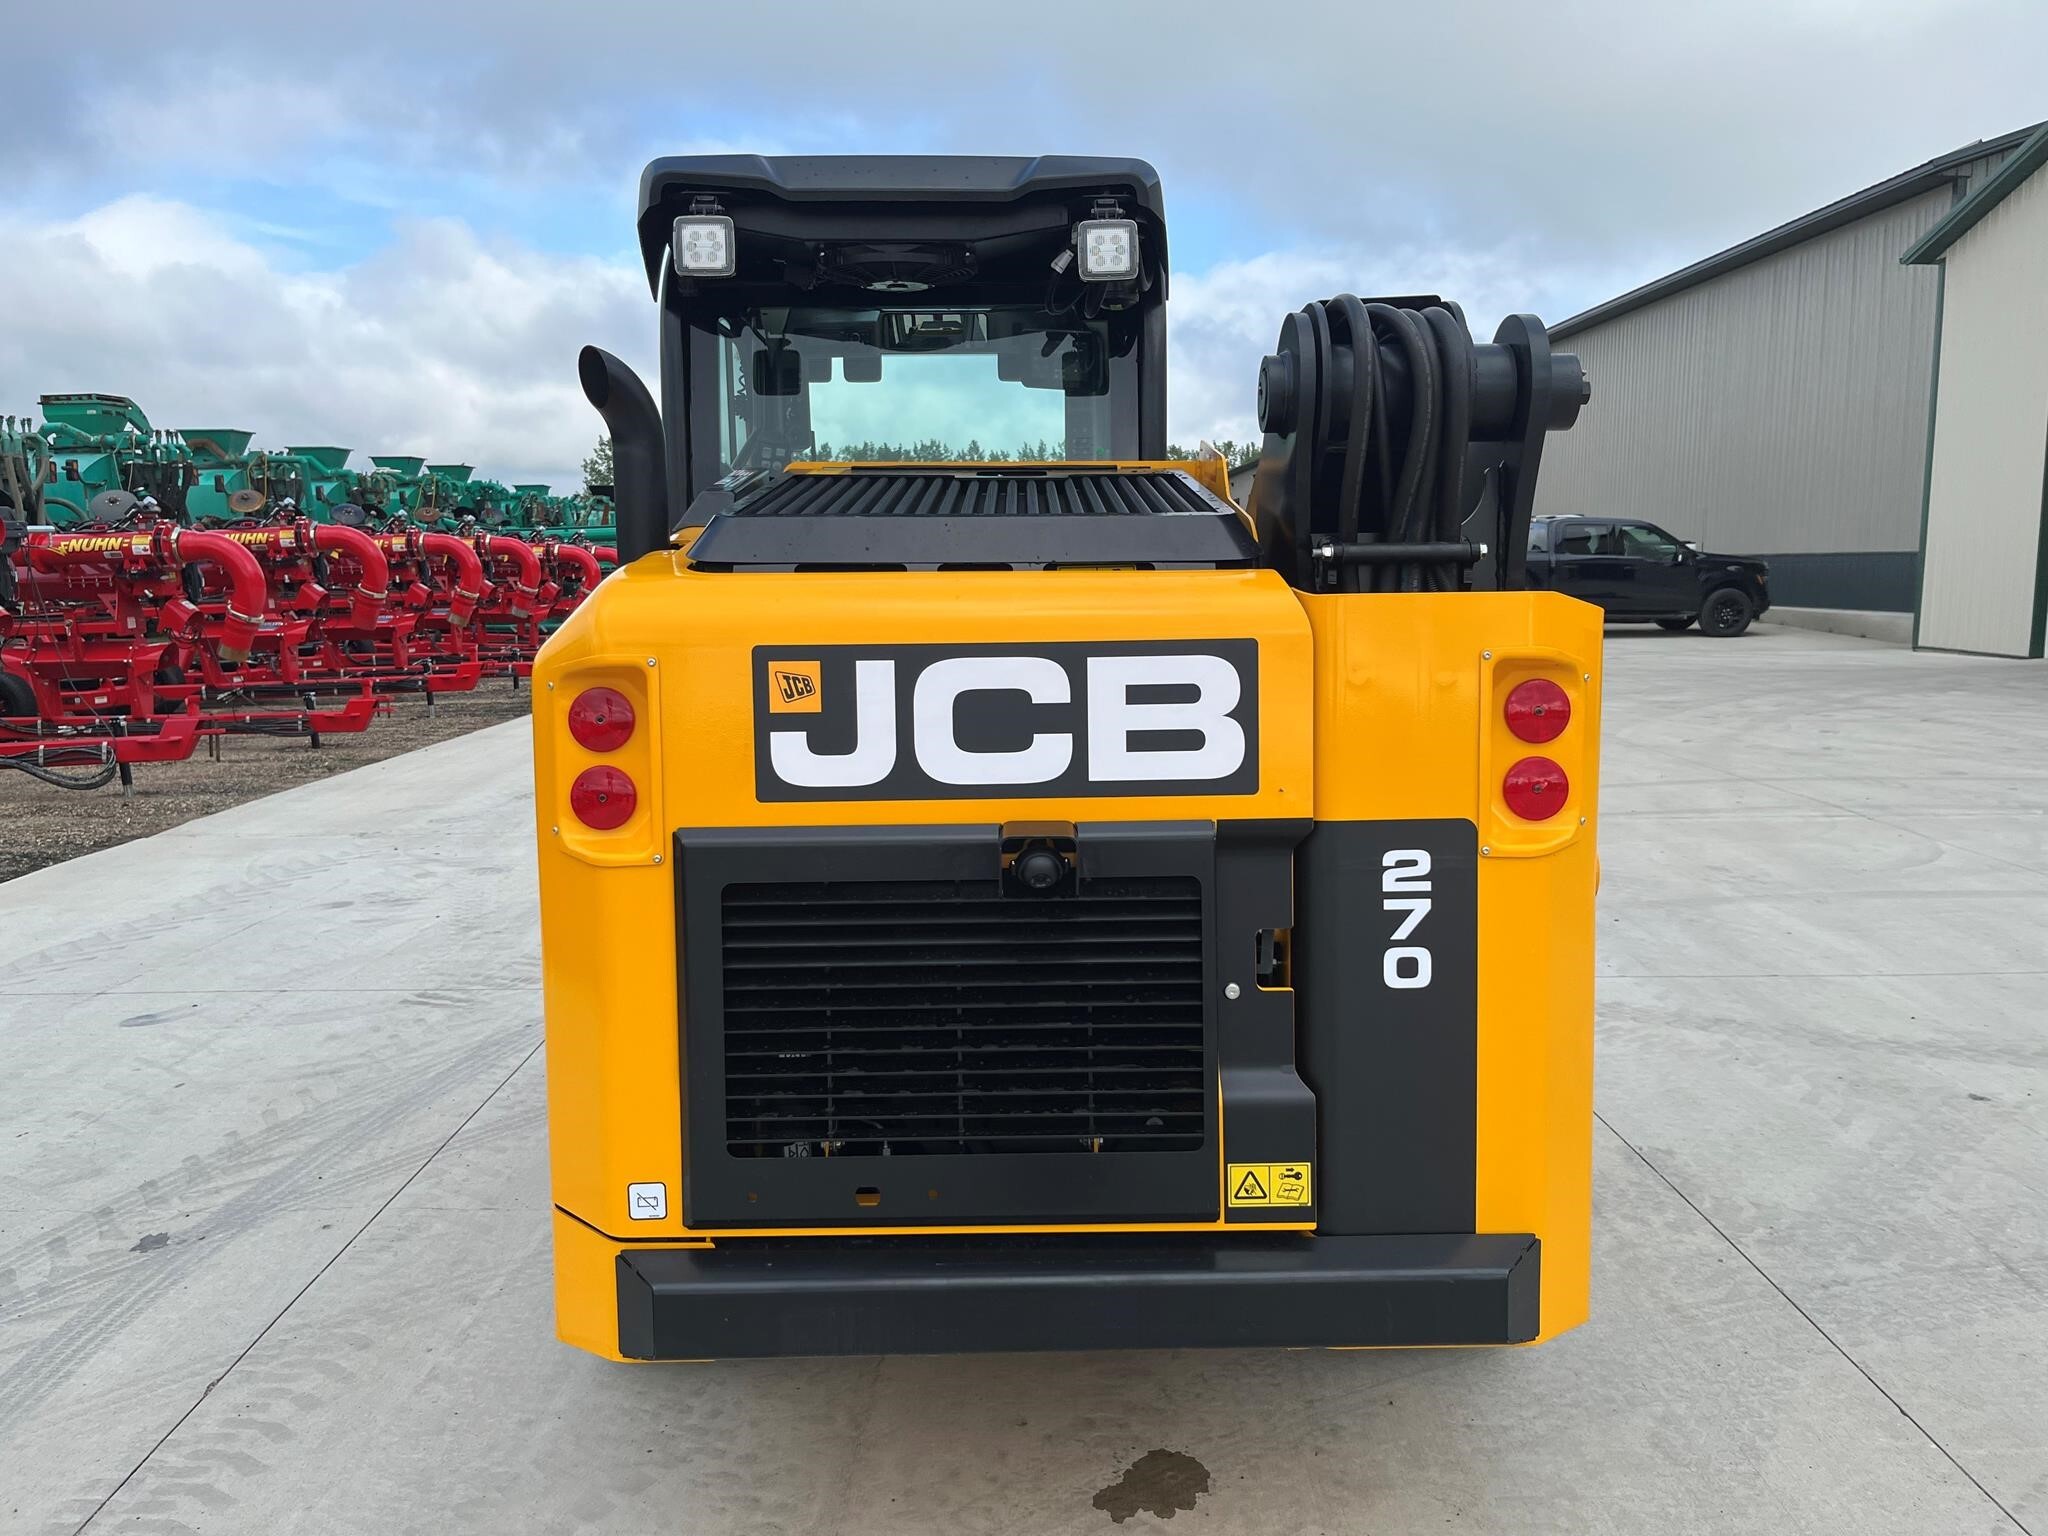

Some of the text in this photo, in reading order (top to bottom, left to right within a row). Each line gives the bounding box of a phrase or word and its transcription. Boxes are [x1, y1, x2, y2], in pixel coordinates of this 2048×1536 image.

[68, 537, 123, 553] NUHN
[770, 655, 1246, 788] JCB
[781, 674, 813, 700] JCB
[1382, 849, 1432, 989] 270
